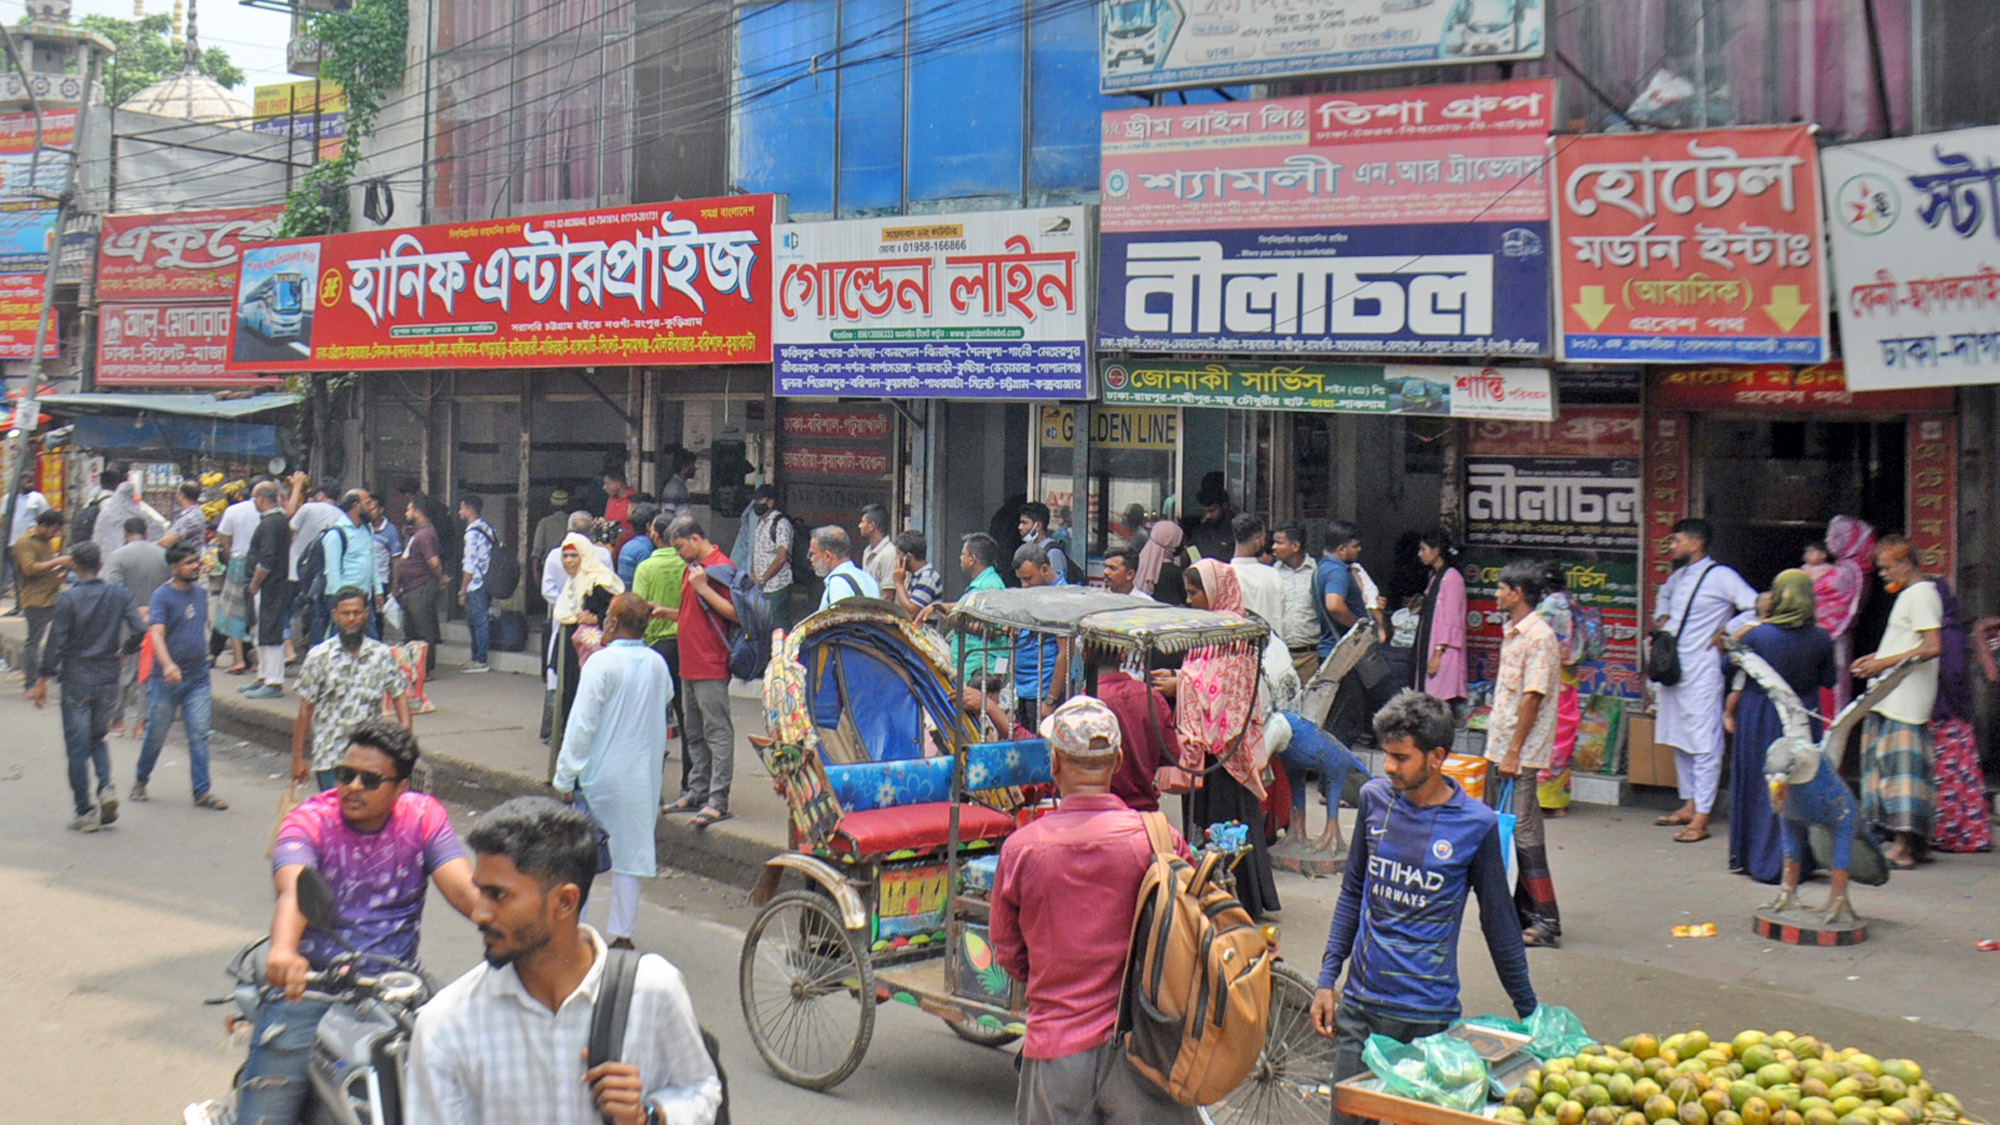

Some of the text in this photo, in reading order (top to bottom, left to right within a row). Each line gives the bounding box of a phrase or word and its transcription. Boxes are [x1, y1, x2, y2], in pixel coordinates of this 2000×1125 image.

[1206, 47, 1234, 58] ঢাকা
[1125, 113, 1173, 139] ড্রীম
[1181, 108, 1251, 133] লাইন
[1259, 104, 1305, 129] লিঃ
[1316, 92, 1544, 129] তিশা গ্রুপ
[1137, 155, 1345, 201] শ্যামলী
[1565, 139, 1805, 220] হোটেল
[720, 204, 755, 217] বাংলাদেশ
[903, 239, 967, 253] 01958-166866
[1694, 221, 1812, 270] ইন্টাঃ
[346, 211, 761, 328] হানিফ এন্টারপ্রাইজ
[779, 235, 1077, 320] গোল্ডেন লাইন
[1124, 240, 1494, 335] নীলাচল
[1622, 271, 1753, 312] (আবাসিক)
[511, 320, 542, 332] সরাসরি
[576, 318, 602, 330] হইতে
[949, 327, 1021, 338] www.goldenlinebd.com
[1628, 316, 1746, 332] প্রবেশ পথ
[1130, 364, 1232, 390] জোনাকী
[1239, 366, 1325, 393] সার্ভিস
[1454, 367, 1507, 402] শান্তি
[1237, 393, 1279, 408] চৌধুরীর
[1137, 412, 1176, 444] LINE
[1468, 463, 1642, 523] নীলাচল
[1368, 854, 1445, 891] ETIHAD
[1371, 883, 1427, 908] AIRWAYS
